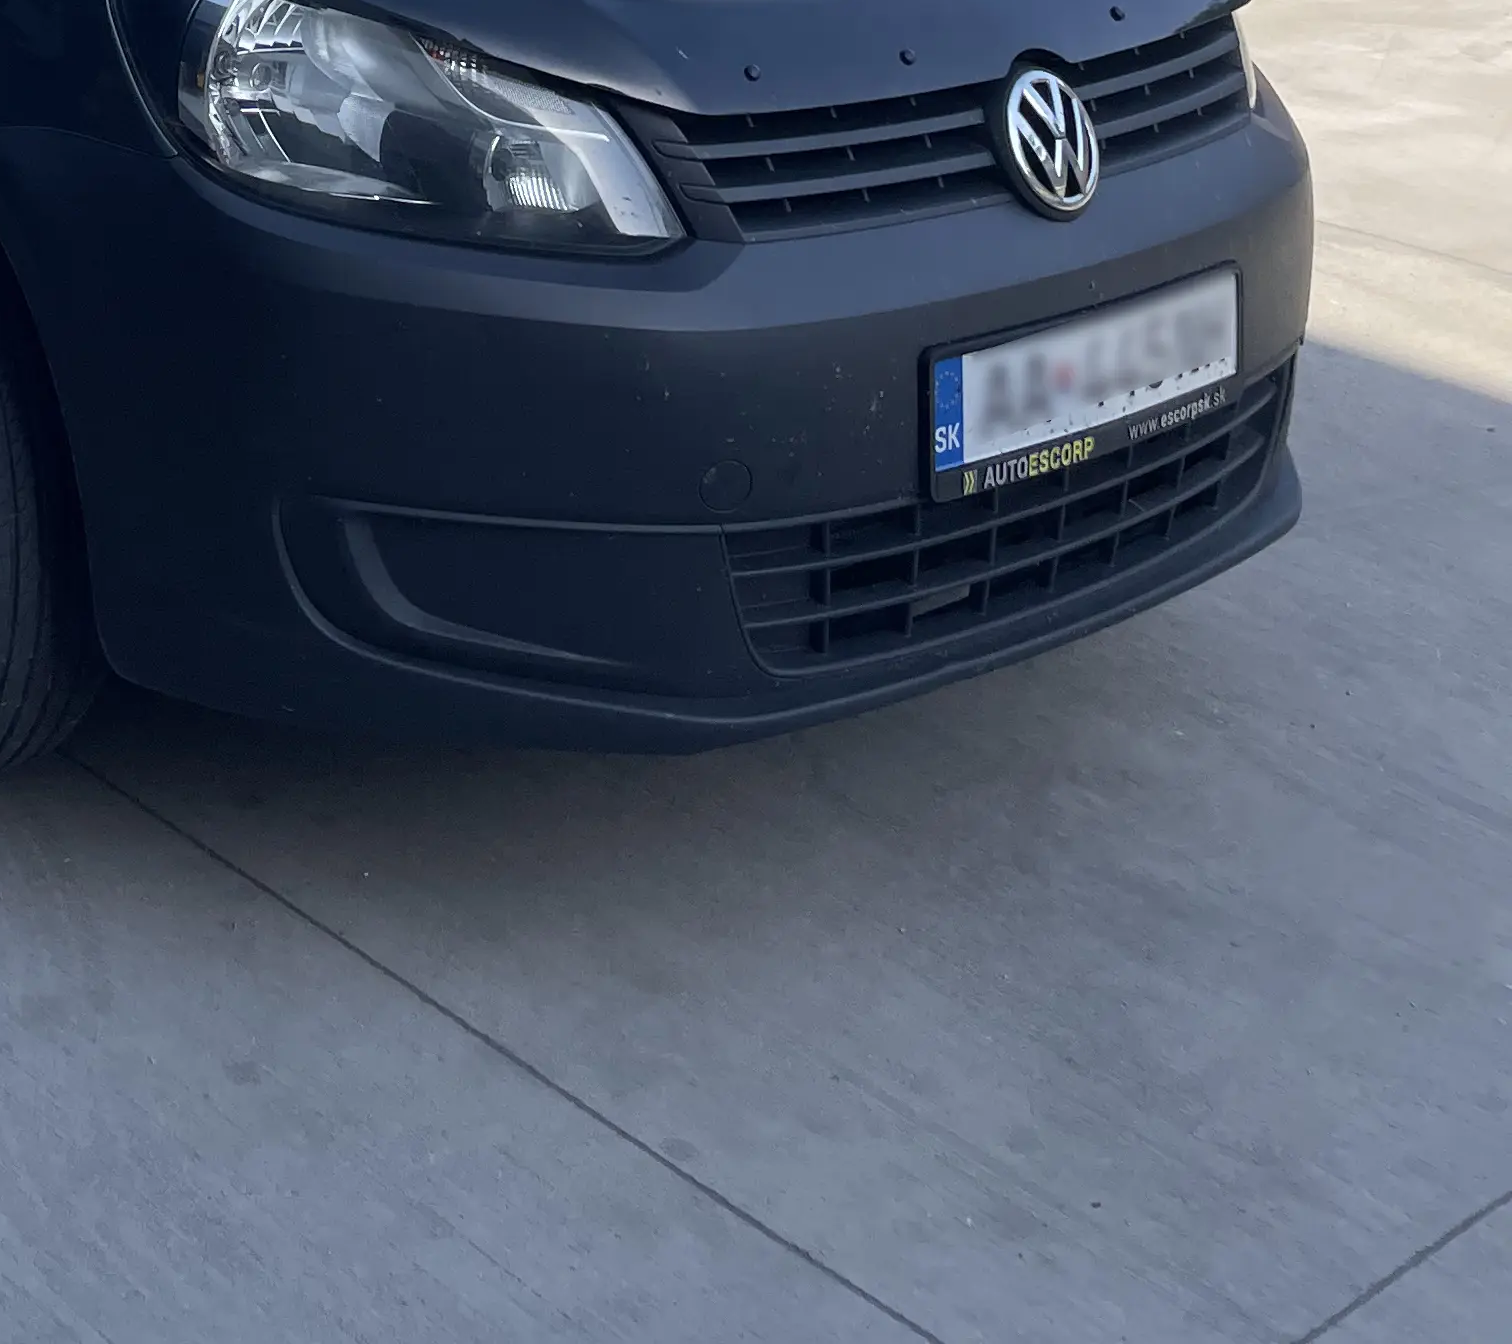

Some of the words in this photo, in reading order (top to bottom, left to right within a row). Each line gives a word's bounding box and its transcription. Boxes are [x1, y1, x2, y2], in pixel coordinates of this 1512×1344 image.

[934, 423, 961, 454] SK
[983, 436, 1095, 489] AUTOESCORP
[1128, 385, 1226, 440] www.escorpsk.sk
